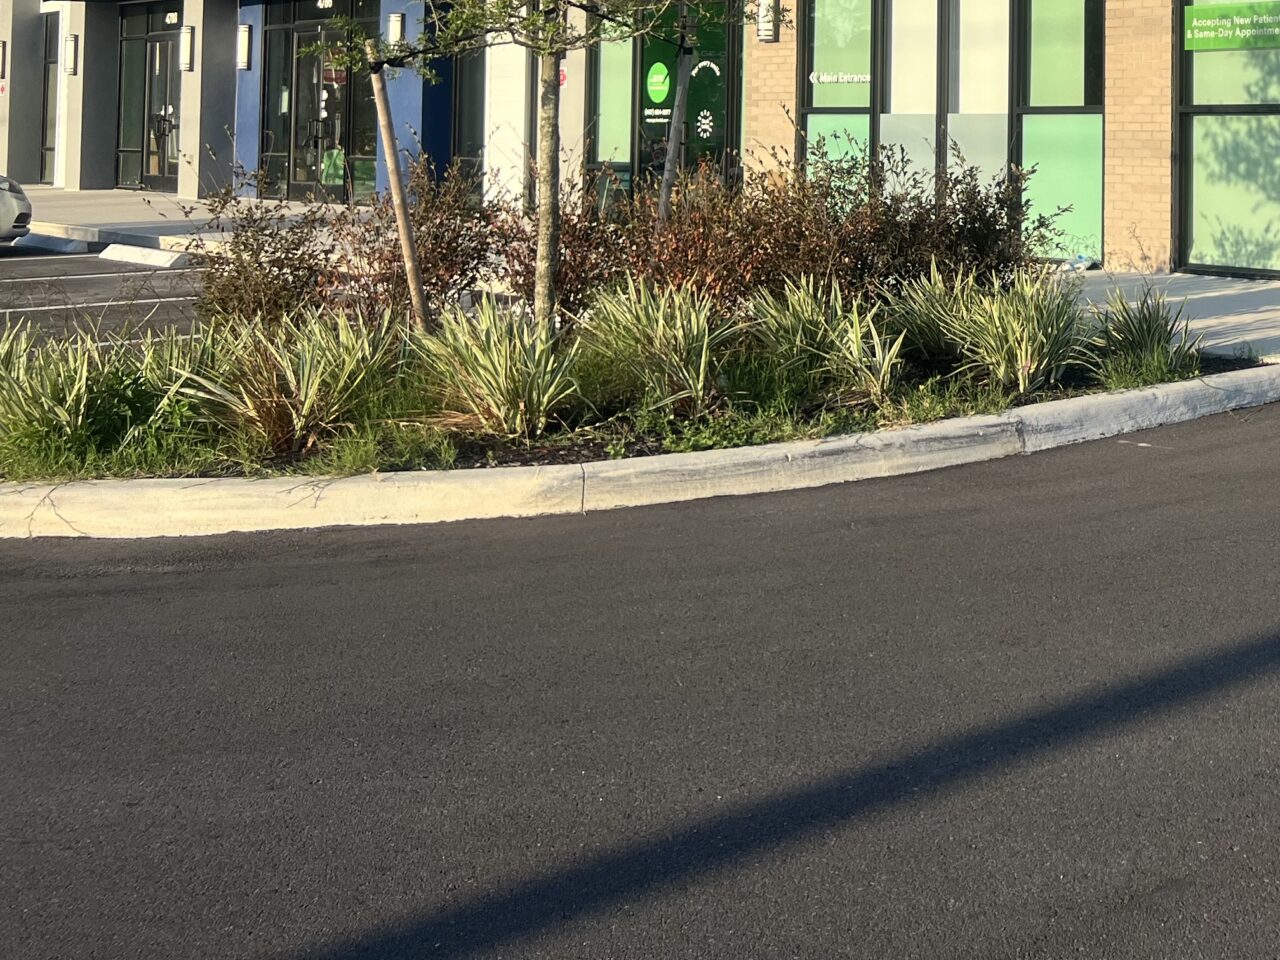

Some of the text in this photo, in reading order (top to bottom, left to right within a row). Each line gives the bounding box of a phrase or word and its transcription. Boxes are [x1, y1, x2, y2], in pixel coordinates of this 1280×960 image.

[1191, 17, 1232, 28] Accepting
[1233, 15, 1252, 25] New
[1186, 29, 1193, 39] &
[1193, 28, 1234, 39] Same-Day
